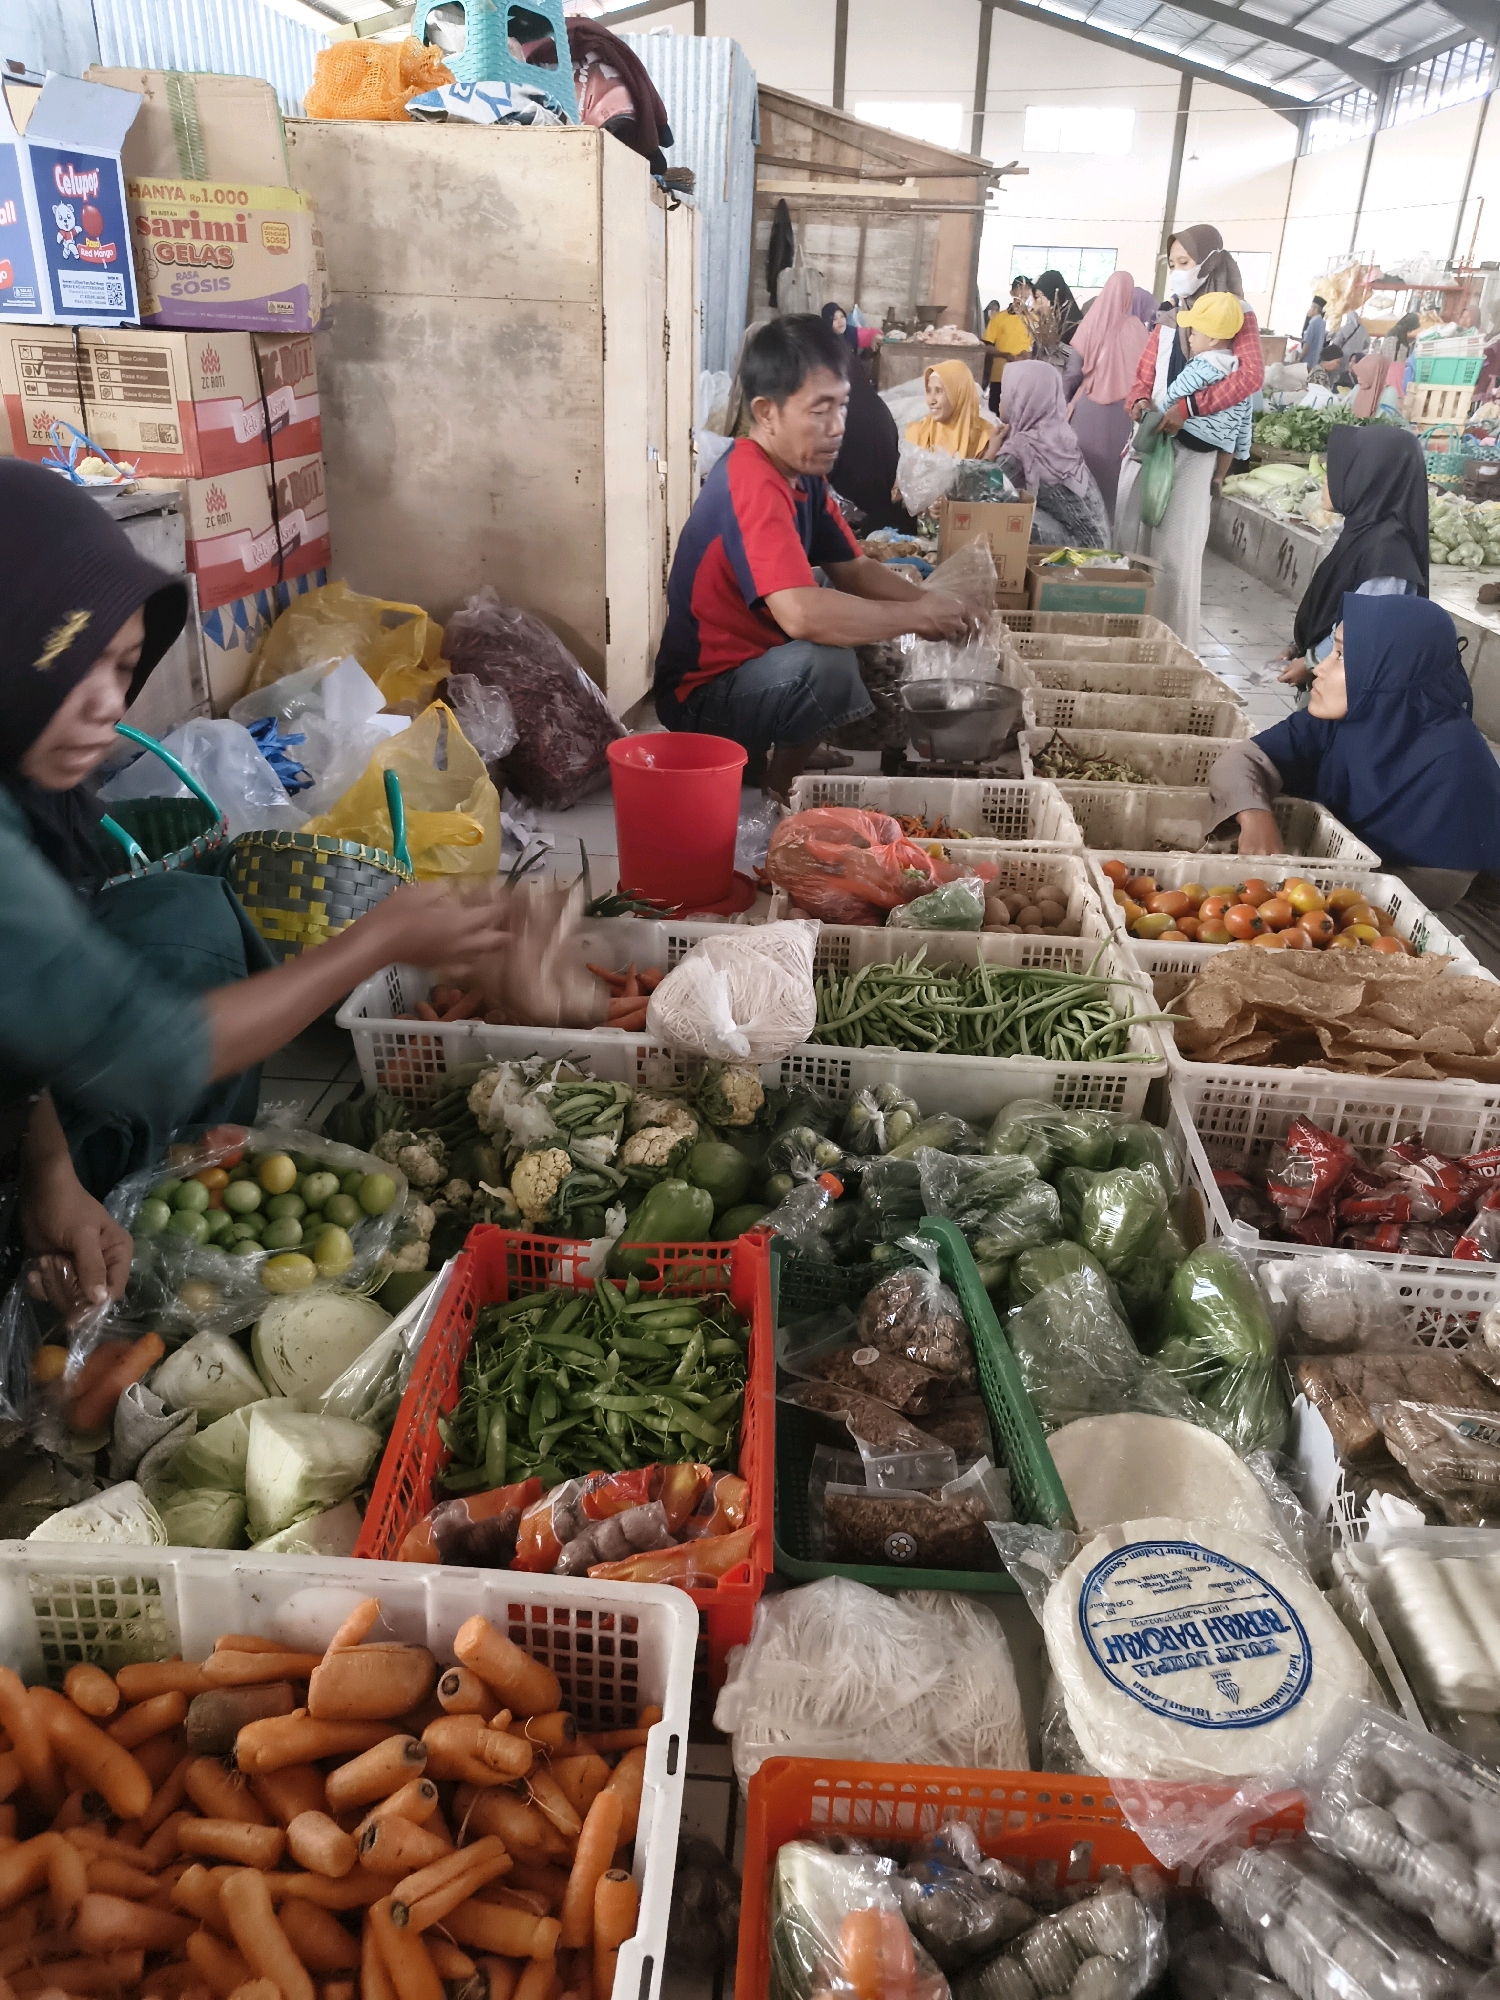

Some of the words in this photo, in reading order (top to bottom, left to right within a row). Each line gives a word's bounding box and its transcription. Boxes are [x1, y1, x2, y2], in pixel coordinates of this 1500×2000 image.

[55, 164, 99, 201] Celupop
[128, 183, 186, 202] HANYA
[190, 187, 249, 206] Rp.1.000
[135, 210, 248, 243] sarimi
[80, 248, 93, 257] Red
[94, 249, 114, 259] Mango
[154, 242, 234, 268] GELAS
[170, 276, 231, 296] SOSIS
[176, 270, 200, 281] RASA
[32, 431, 43, 439] ZC
[45, 432, 64, 440] RTI
[1215, 1639, 1281, 1663] KULIT
[1132, 1650, 1215, 1678] LUMPIA
[1133, 1681, 1169, 1708] Lama
[1260, 1679, 1294, 1709] Mudah
[1171, 1700, 1214, 1721] Tahan
